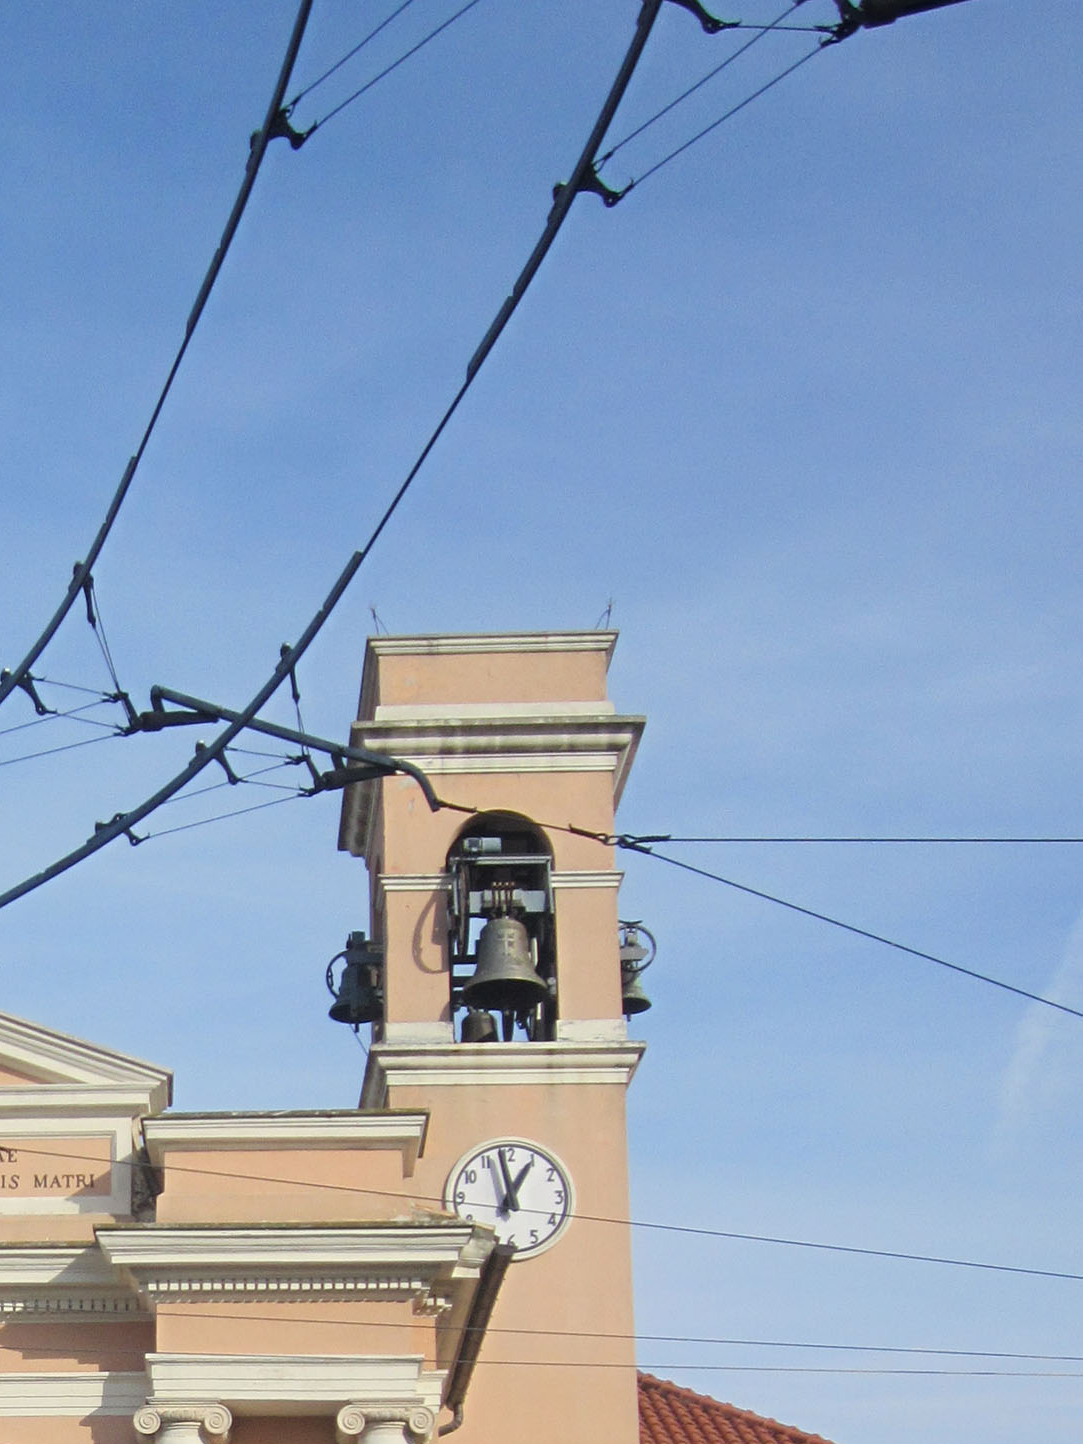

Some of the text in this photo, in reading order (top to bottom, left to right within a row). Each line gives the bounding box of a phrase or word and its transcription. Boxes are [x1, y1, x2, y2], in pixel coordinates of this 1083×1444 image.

[481, 1155, 490, 1168] 11
[33, 1173, 95, 1189] MATRI
[465, 1170, 477, 1184] 10
[546, 1168, 555, 1182] 2
[457, 1192, 465, 1205] 9
[554, 1191, 563, 1204] 3
[548, 1213, 556, 1226] 4
[530, 1230, 538, 1243] 5
